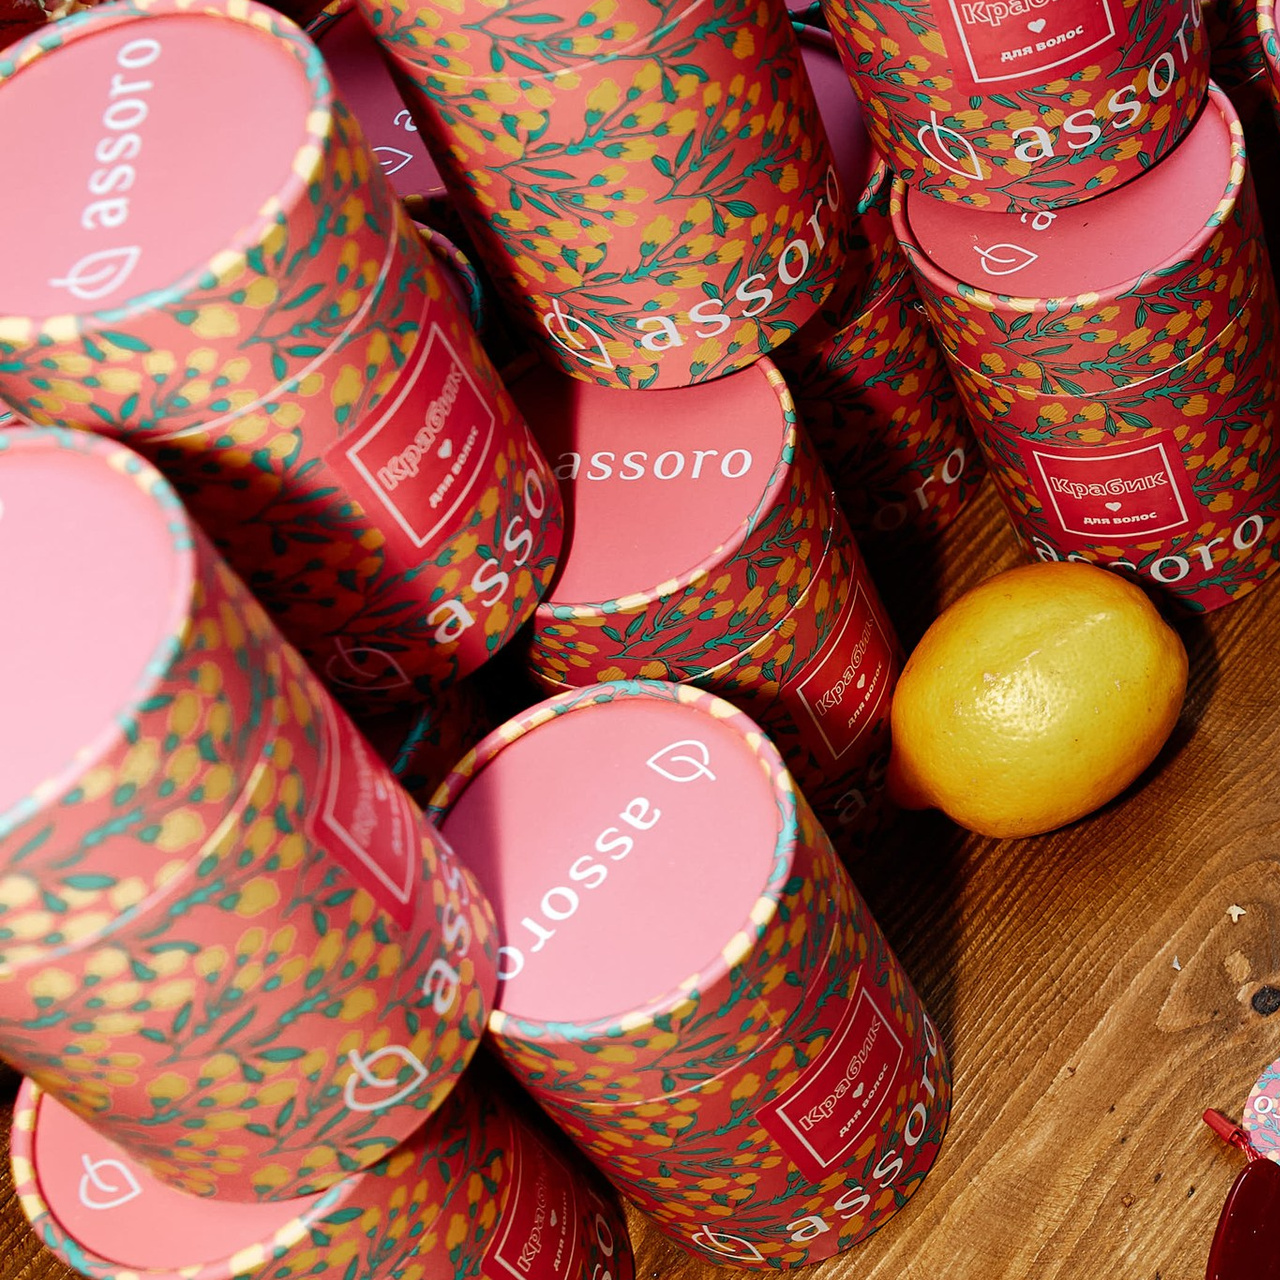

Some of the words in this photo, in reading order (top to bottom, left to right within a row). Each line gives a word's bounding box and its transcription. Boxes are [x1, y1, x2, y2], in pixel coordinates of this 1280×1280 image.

[1001, 44, 1033, 63] для
[1036, 25, 1084, 51] волос
[81, 36, 161, 229] assoro
[636, 164, 840, 352] assoro
[553, 448, 753, 480] assoro
[1050, 471, 1168, 499] Крабик
[427, 422, 546, 644] assor
[1033, 514, 1264, 583] aoro
[1083, 516, 1111, 525] для
[1112, 511, 1158, 524] волос
[496, 796, 661, 980] assoro
[799, 1015, 881, 1132] Крабик
[839, 1110, 861, 1138] для
[861, 1063, 888, 1109] волос
[786, 1014, 938, 1242] assoro
